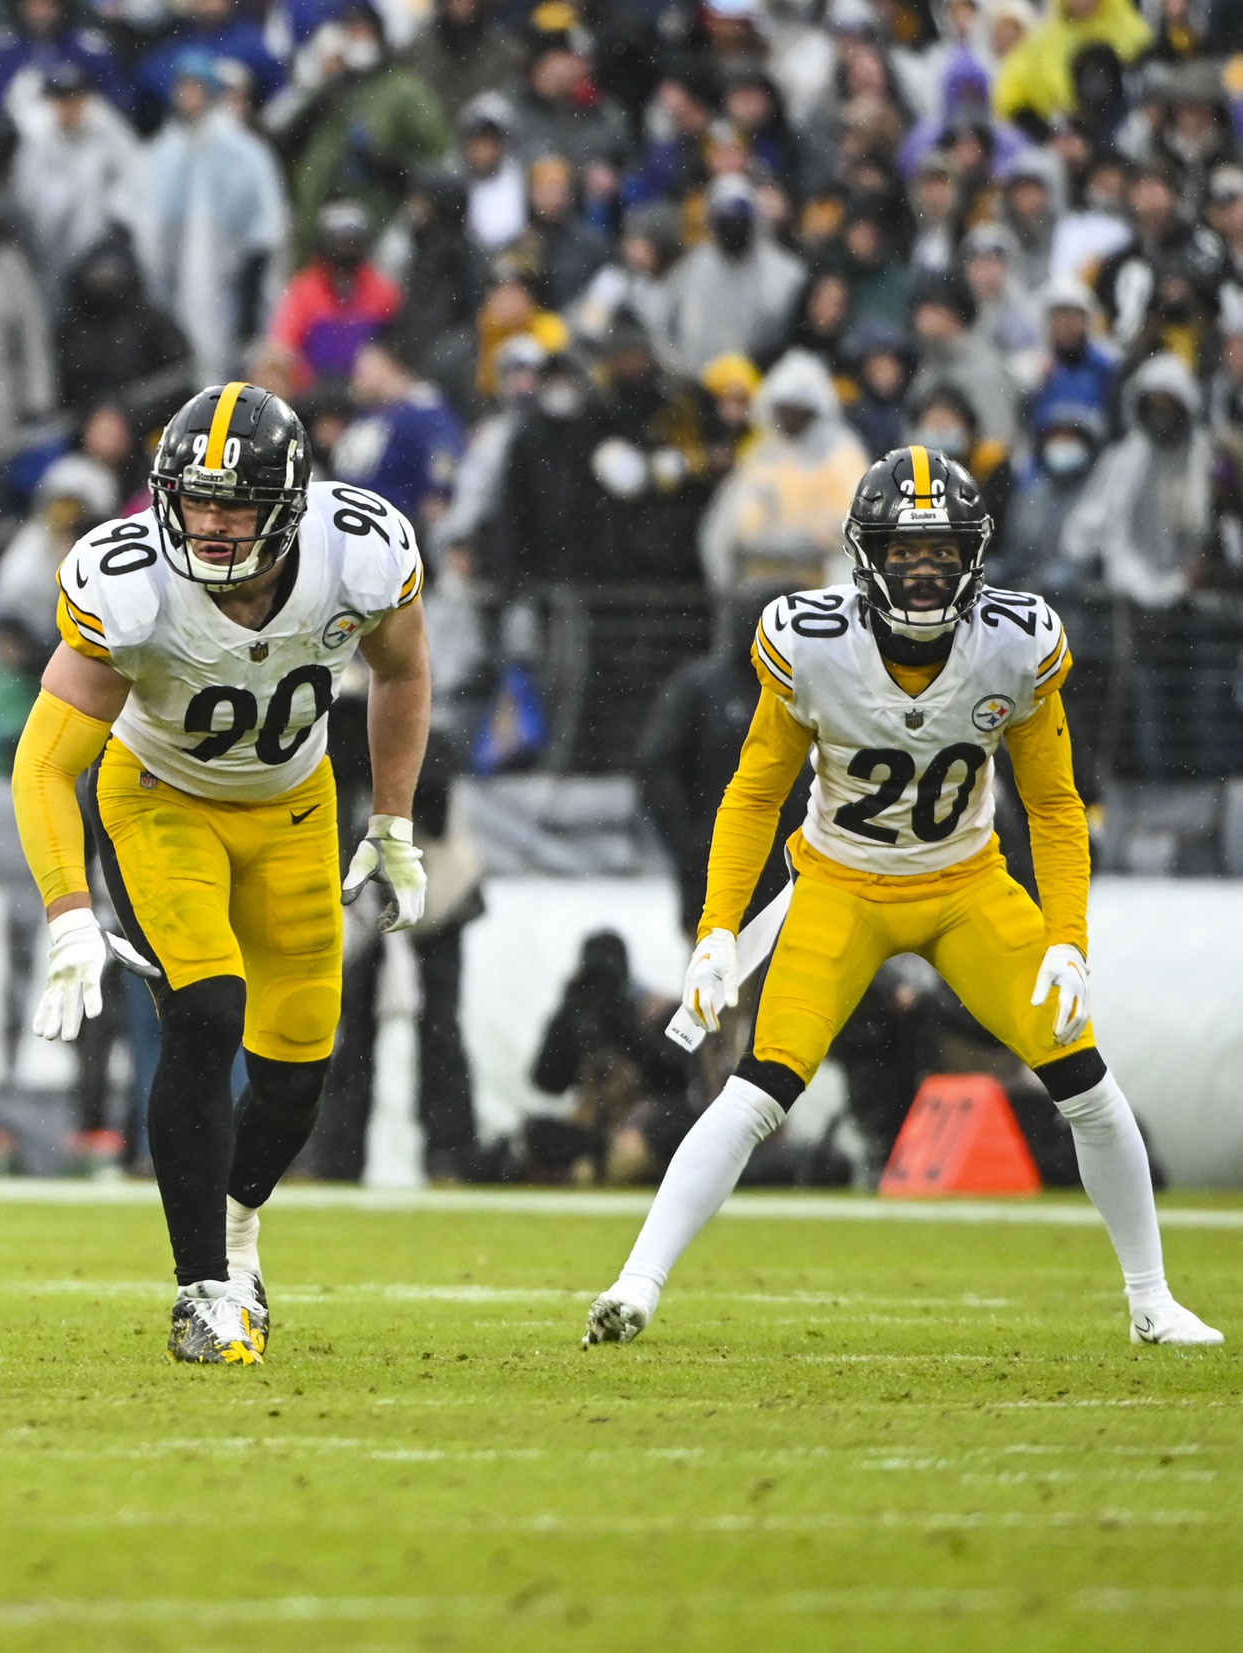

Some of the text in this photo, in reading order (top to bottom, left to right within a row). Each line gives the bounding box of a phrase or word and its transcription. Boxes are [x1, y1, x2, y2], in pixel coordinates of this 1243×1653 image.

[192, 434, 241, 469] 90
[332, 487, 391, 547] 90
[897, 479, 946, 509] 20
[910, 511, 937, 520] Steelers
[90, 522, 158, 576] 90
[786, 594, 849, 638] 20
[980, 590, 1037, 637] 20
[181, 663, 335, 766] 90
[833, 741, 987, 845] 20
